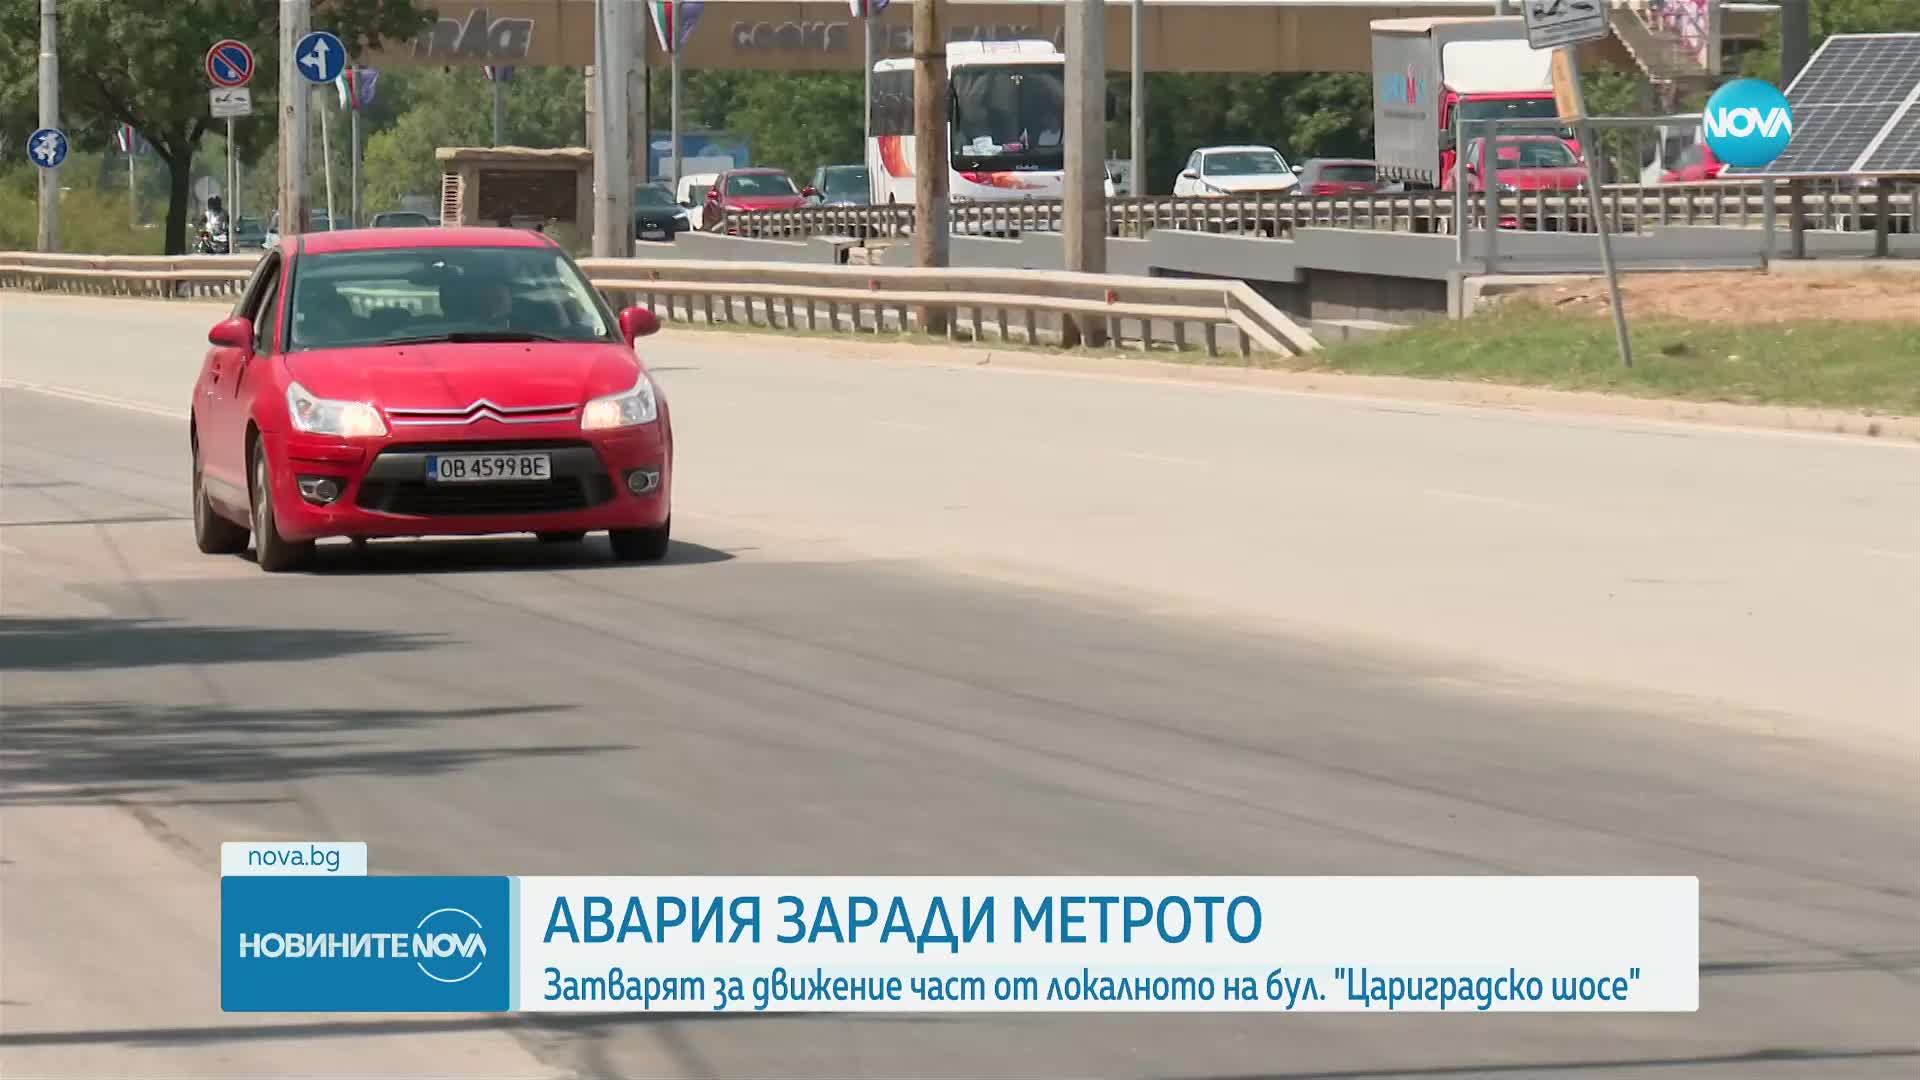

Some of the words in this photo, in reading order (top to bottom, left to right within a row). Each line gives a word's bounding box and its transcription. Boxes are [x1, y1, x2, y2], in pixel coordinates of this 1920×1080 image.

[441, 459, 465, 478] OB
[471, 457, 515, 476] 4599
[521, 457, 547, 476] BE
